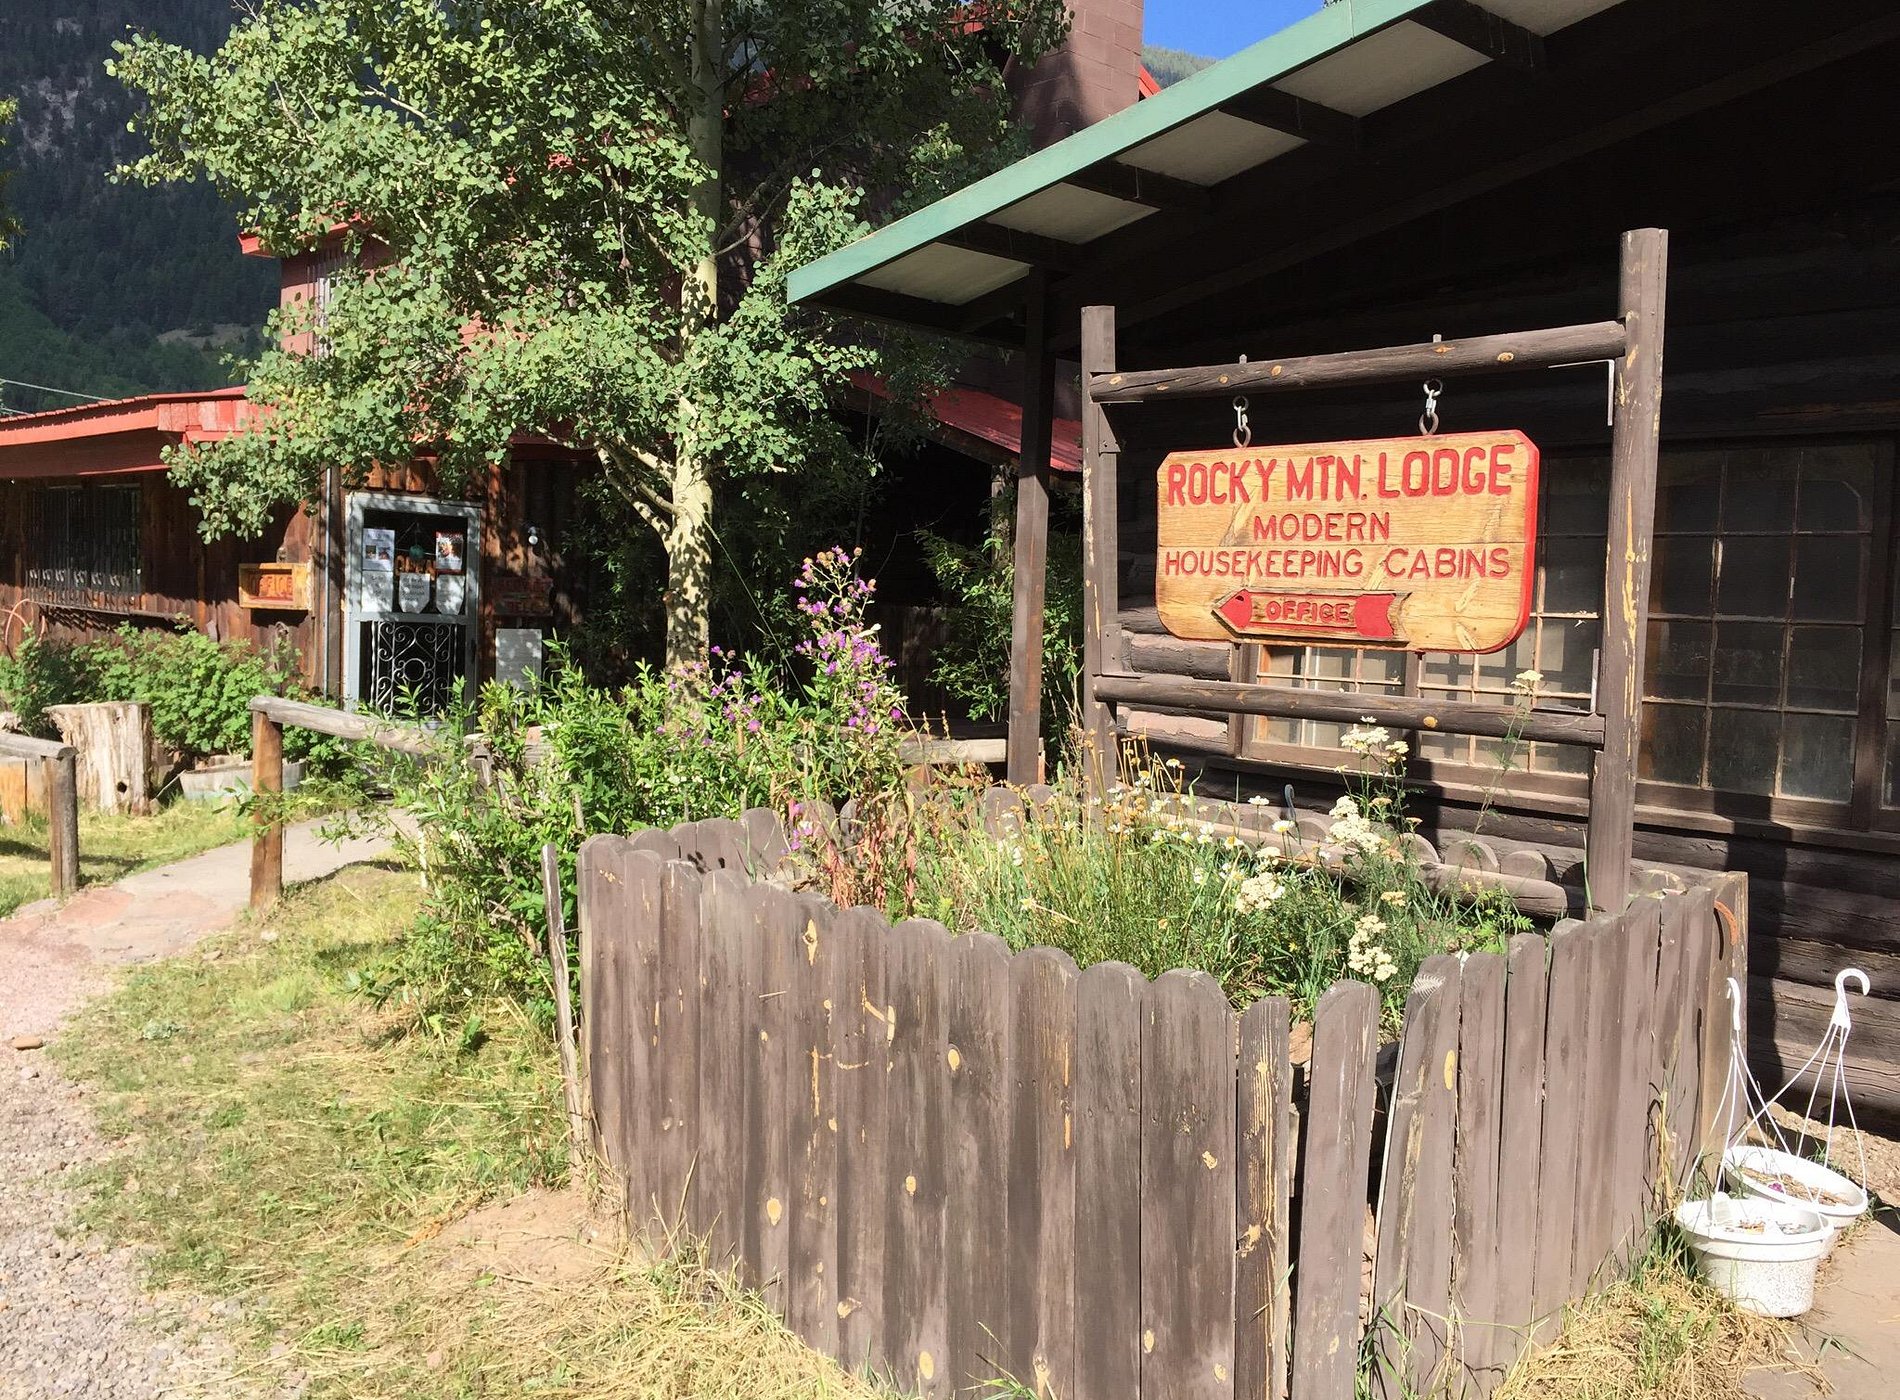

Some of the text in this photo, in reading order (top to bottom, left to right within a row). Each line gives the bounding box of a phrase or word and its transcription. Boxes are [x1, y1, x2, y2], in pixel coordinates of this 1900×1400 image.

[1166, 444, 1516, 507] ROCKY MTN. LODGE
[1253, 511, 1390, 543] MODERN
[1164, 547, 1511, 579] HOUSEKEEPING CABINS
[1265, 600, 1351, 623] OFFICE
